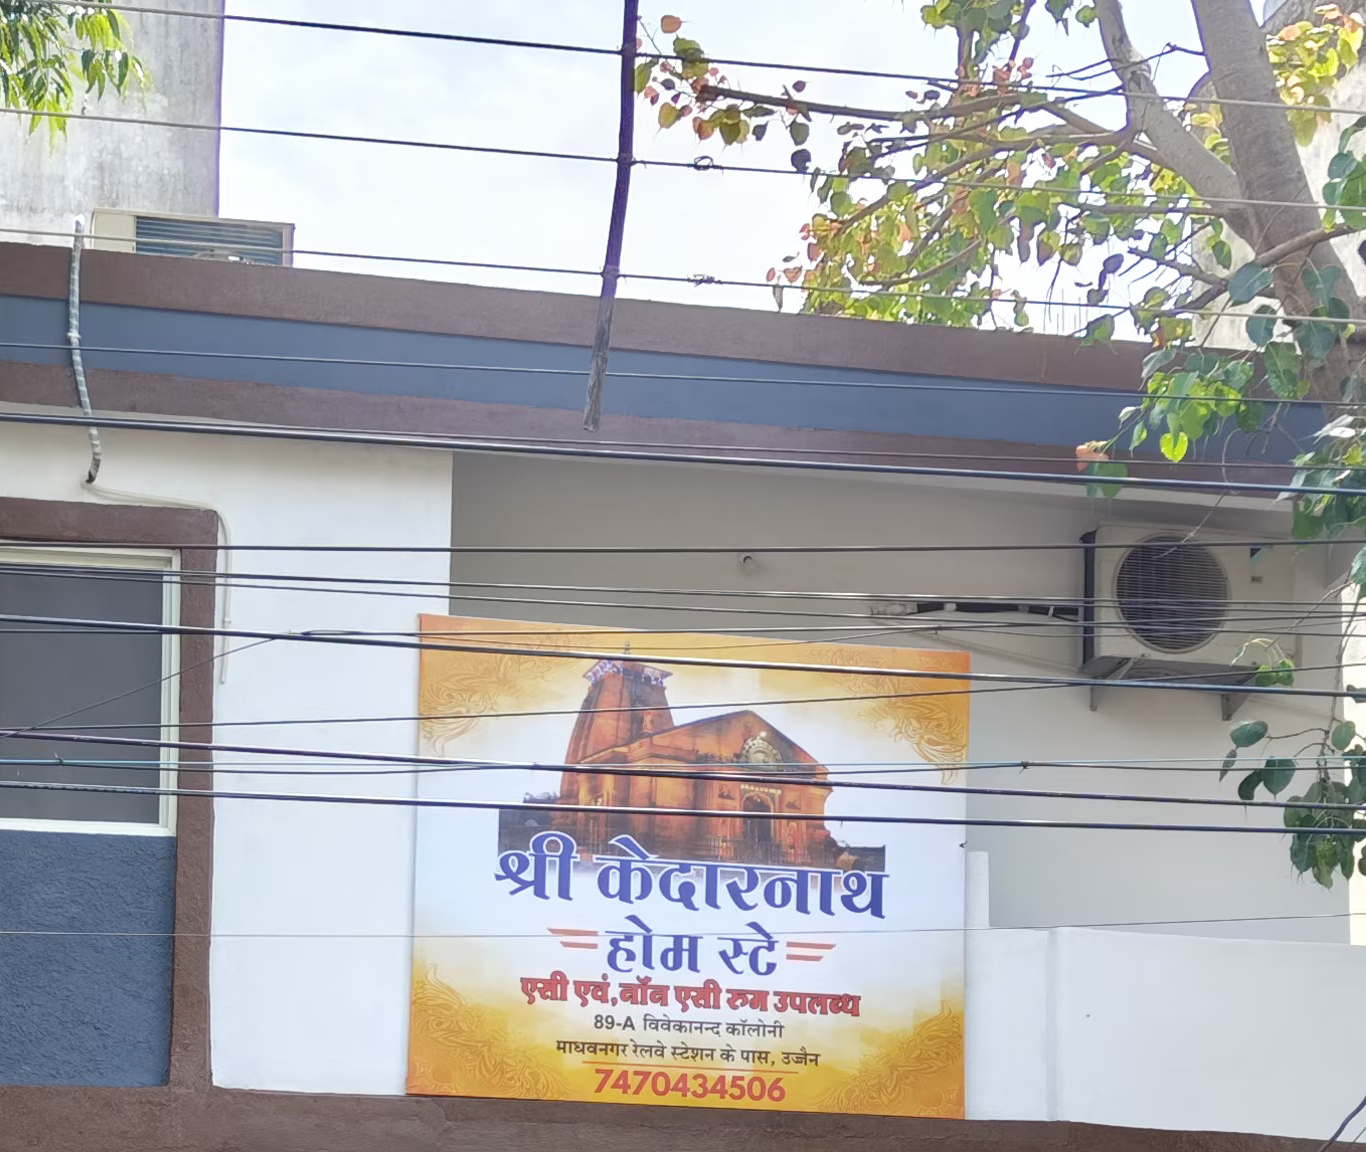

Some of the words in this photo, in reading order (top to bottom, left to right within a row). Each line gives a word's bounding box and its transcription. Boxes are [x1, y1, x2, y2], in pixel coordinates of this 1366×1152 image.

[494, 830, 579, 901] श्री
[593, 833, 890, 920] केदारनाथ
[603, 914, 704, 974] होम
[717, 921, 780, 976] स्टे
[520, 970, 569, 1003] एसी
[674, 979, 721, 1012] एसी
[773, 989, 861, 1017] उपलब्ध
[594, 1014, 635, 1031] 89-A
[725, 1017, 785, 1039] कॉलोनी
[556, 1040, 629, 1057] माधवनगर
[632, 1040, 667, 1059] रेलवे
[671, 1042, 717, 1062] स्टेशन
[720, 1044, 736, 1062] के
[781, 1045, 821, 1067] उज्जैन
[594, 1068, 786, 1102] 7470434506
